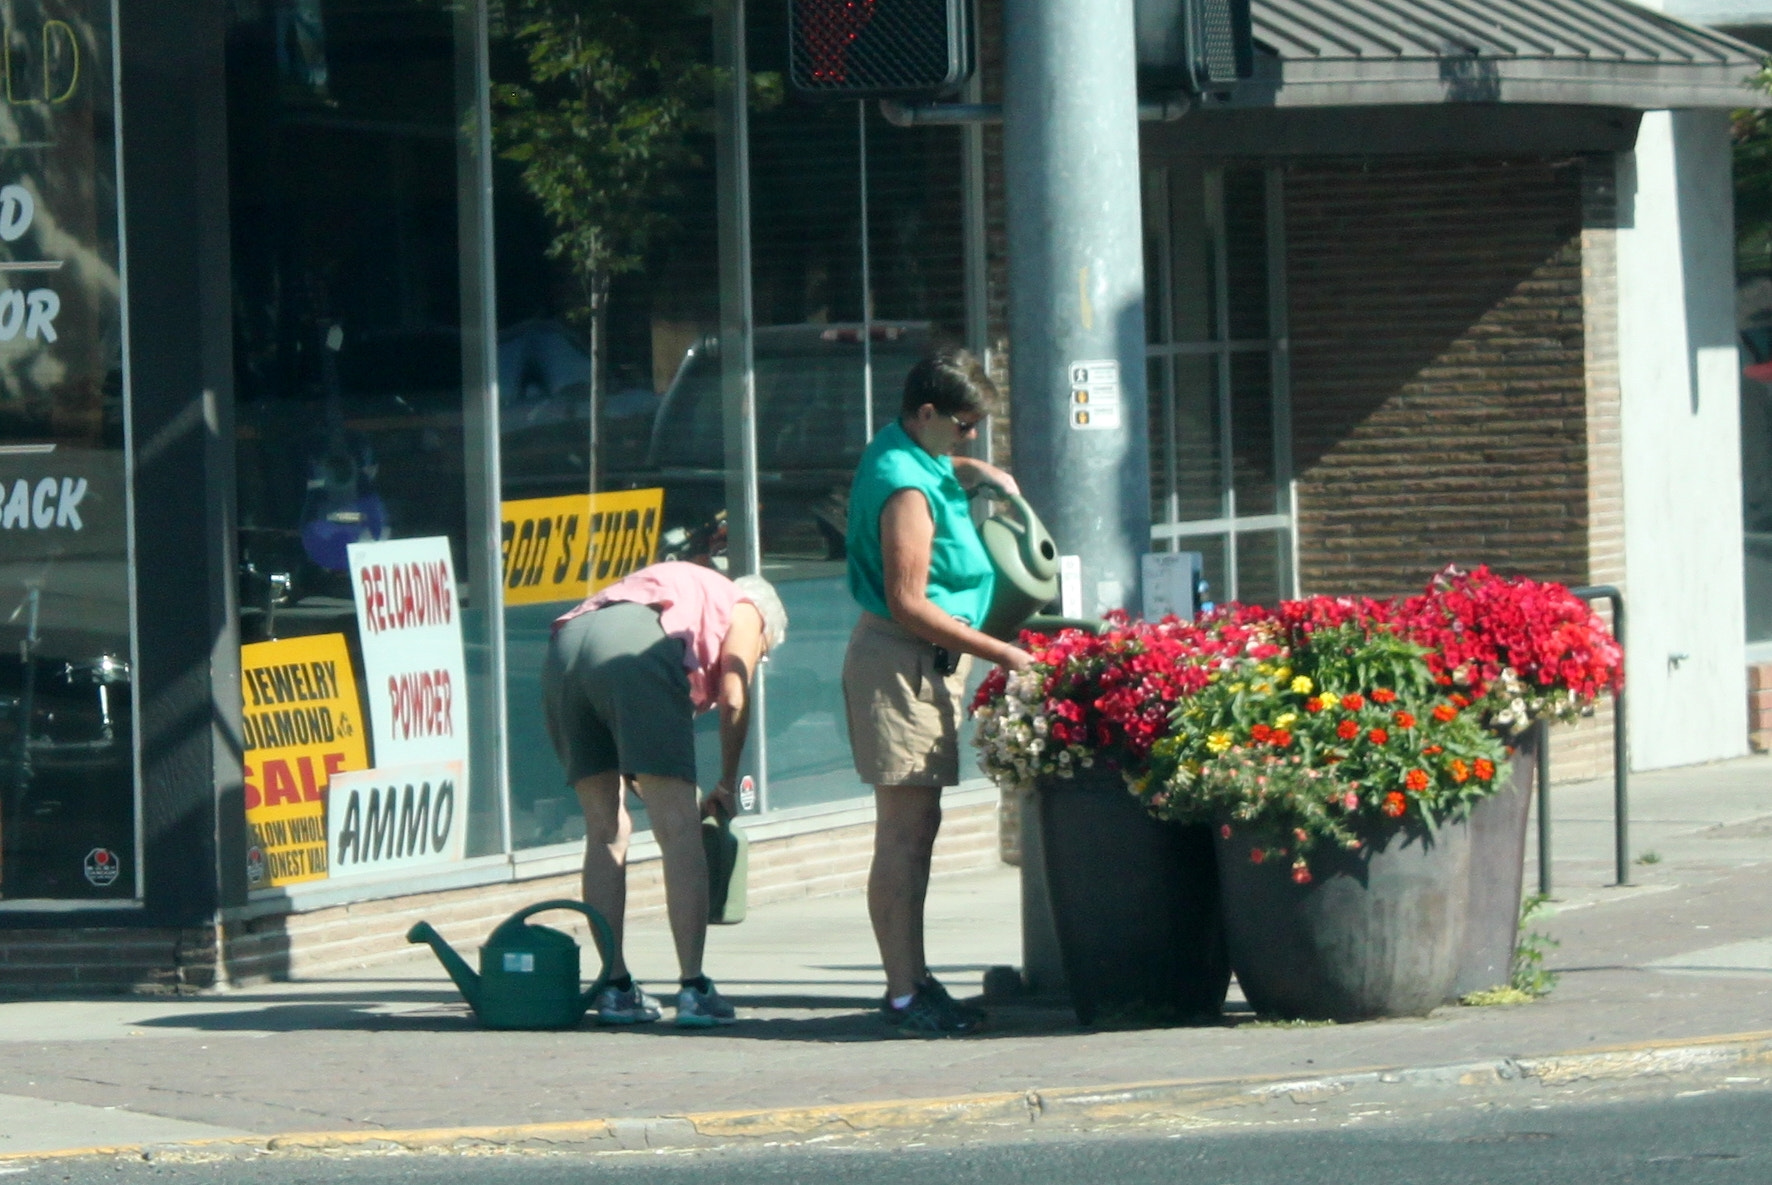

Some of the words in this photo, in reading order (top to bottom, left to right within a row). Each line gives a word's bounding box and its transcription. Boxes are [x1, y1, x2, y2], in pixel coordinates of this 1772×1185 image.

[0, 288, 60, 343] OR
[0, 476, 88, 531] ACK
[361, 558, 451, 634] RELOADING
[245, 661, 339, 706] JEWELRY
[388, 669, 453, 741] POWDER
[243, 706, 335, 750] DIAMOND
[337, 779, 454, 866] AMMO
